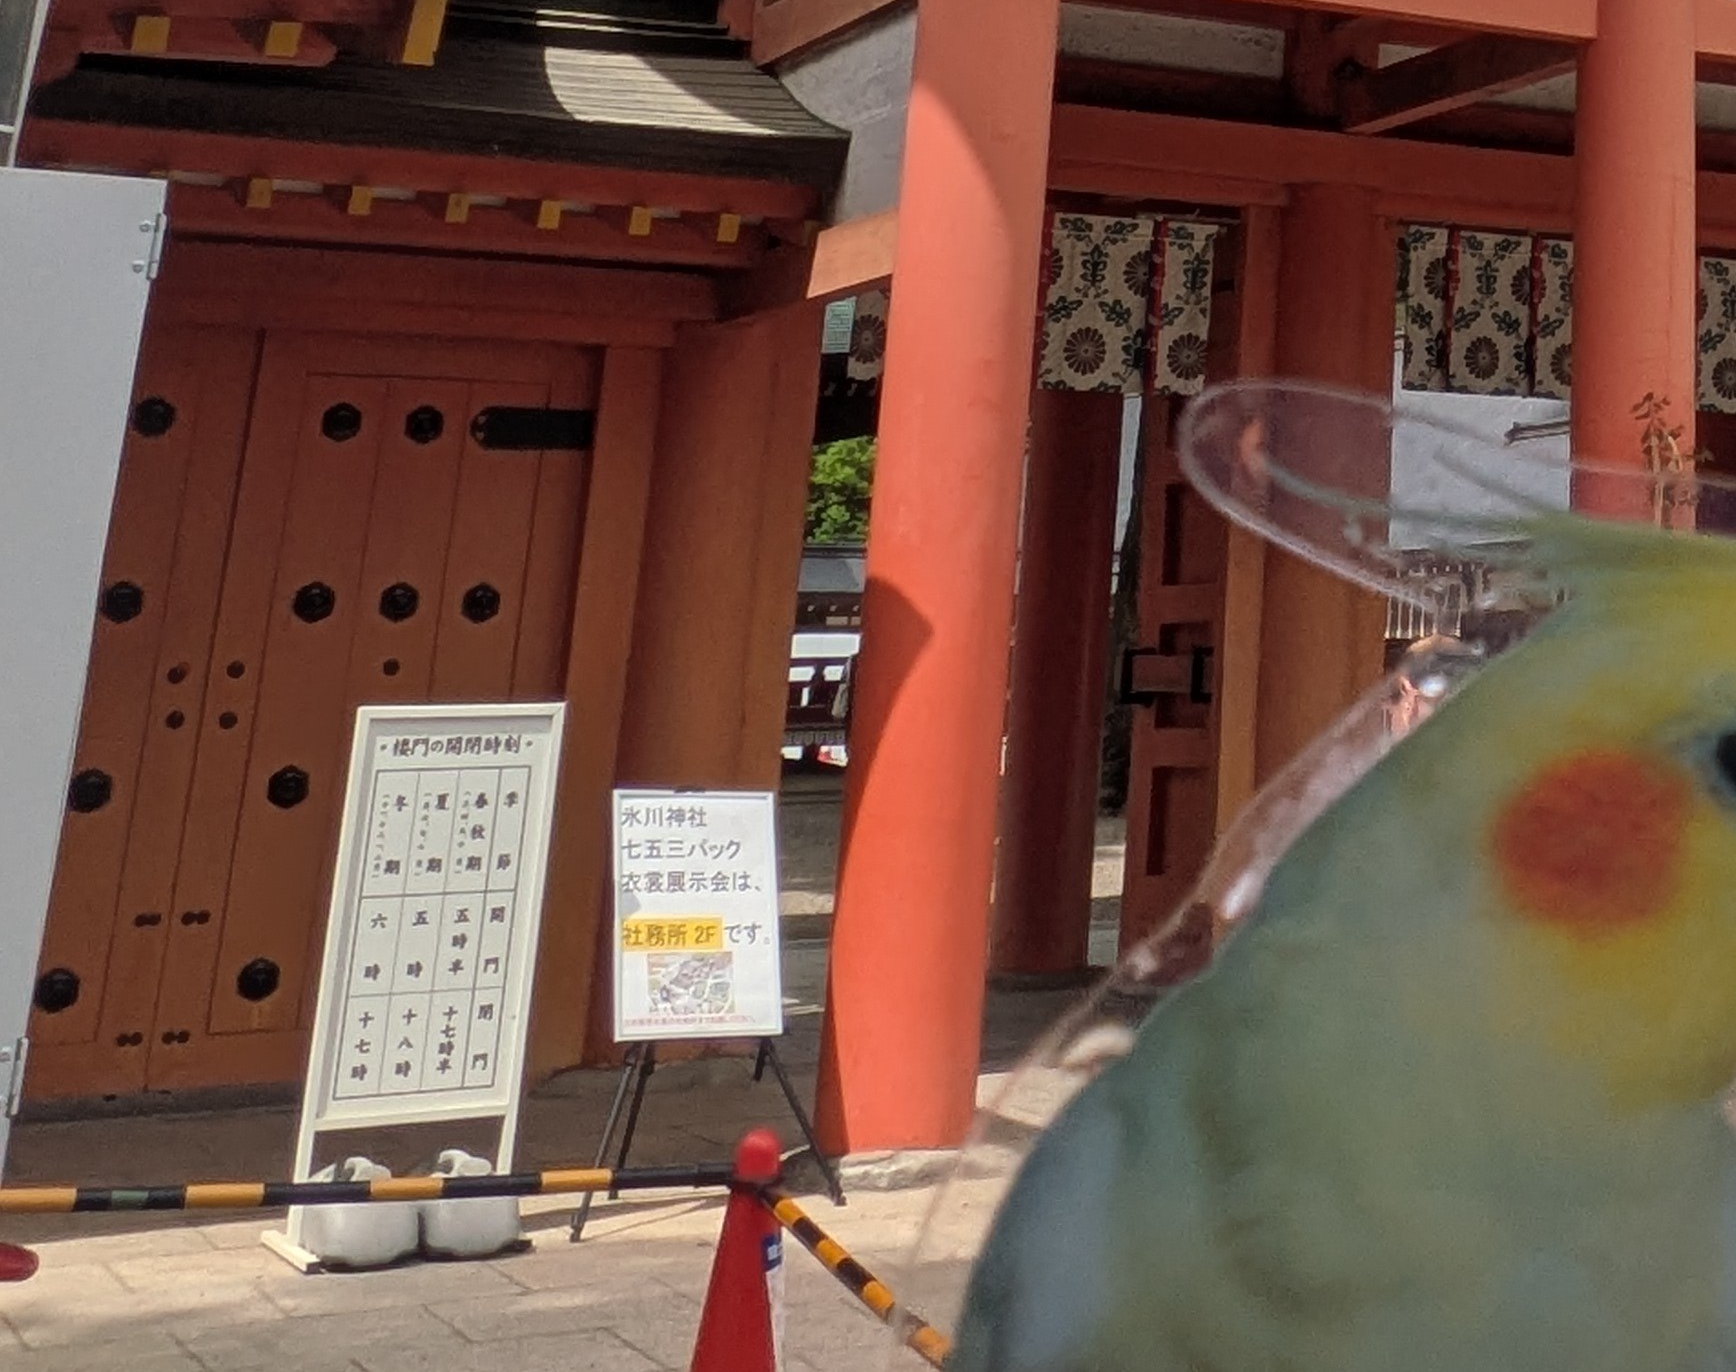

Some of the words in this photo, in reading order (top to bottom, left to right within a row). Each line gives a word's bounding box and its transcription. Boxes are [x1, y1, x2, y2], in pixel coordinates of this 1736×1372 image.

[621, 806, 708, 828] 氷川神社
[621, 839, 741, 860] 七五三パック
